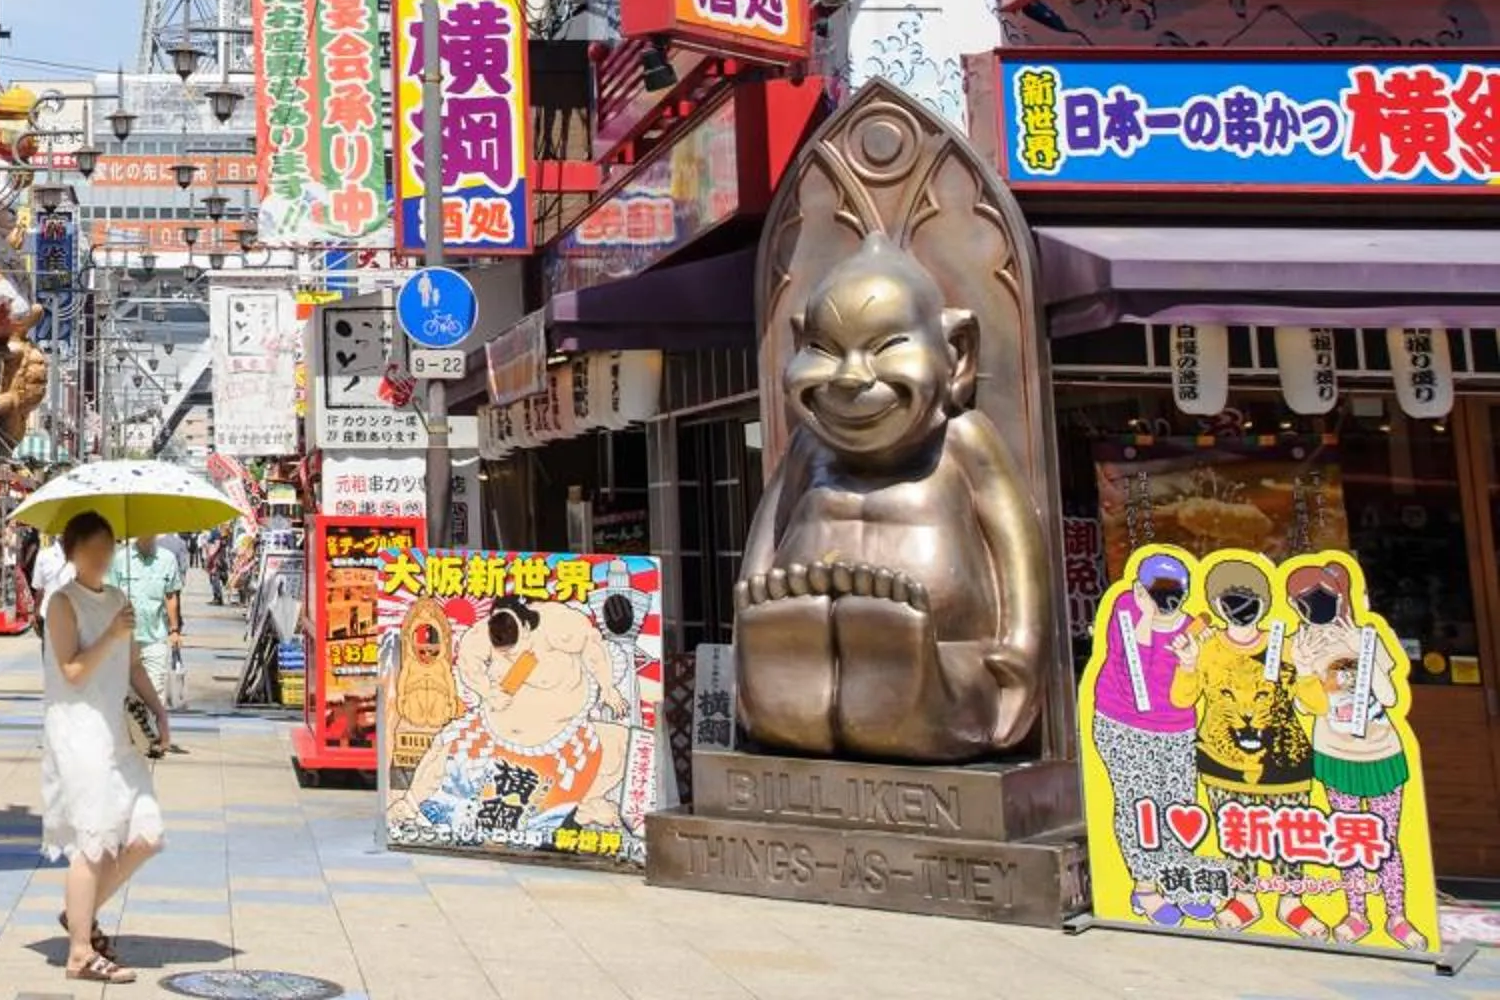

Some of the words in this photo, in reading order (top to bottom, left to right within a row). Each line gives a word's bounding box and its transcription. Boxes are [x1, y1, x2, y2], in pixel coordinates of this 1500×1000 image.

[408, 3, 511, 191] 横綱
[1021, 71, 1060, 171] 新世界
[1065, 91, 1340, 152] 日本一の串かつ
[384, 554, 596, 603] 大阪新世界
[725, 768, 962, 831] BILLIKEN
[1221, 803, 1387, 867] 新世界
